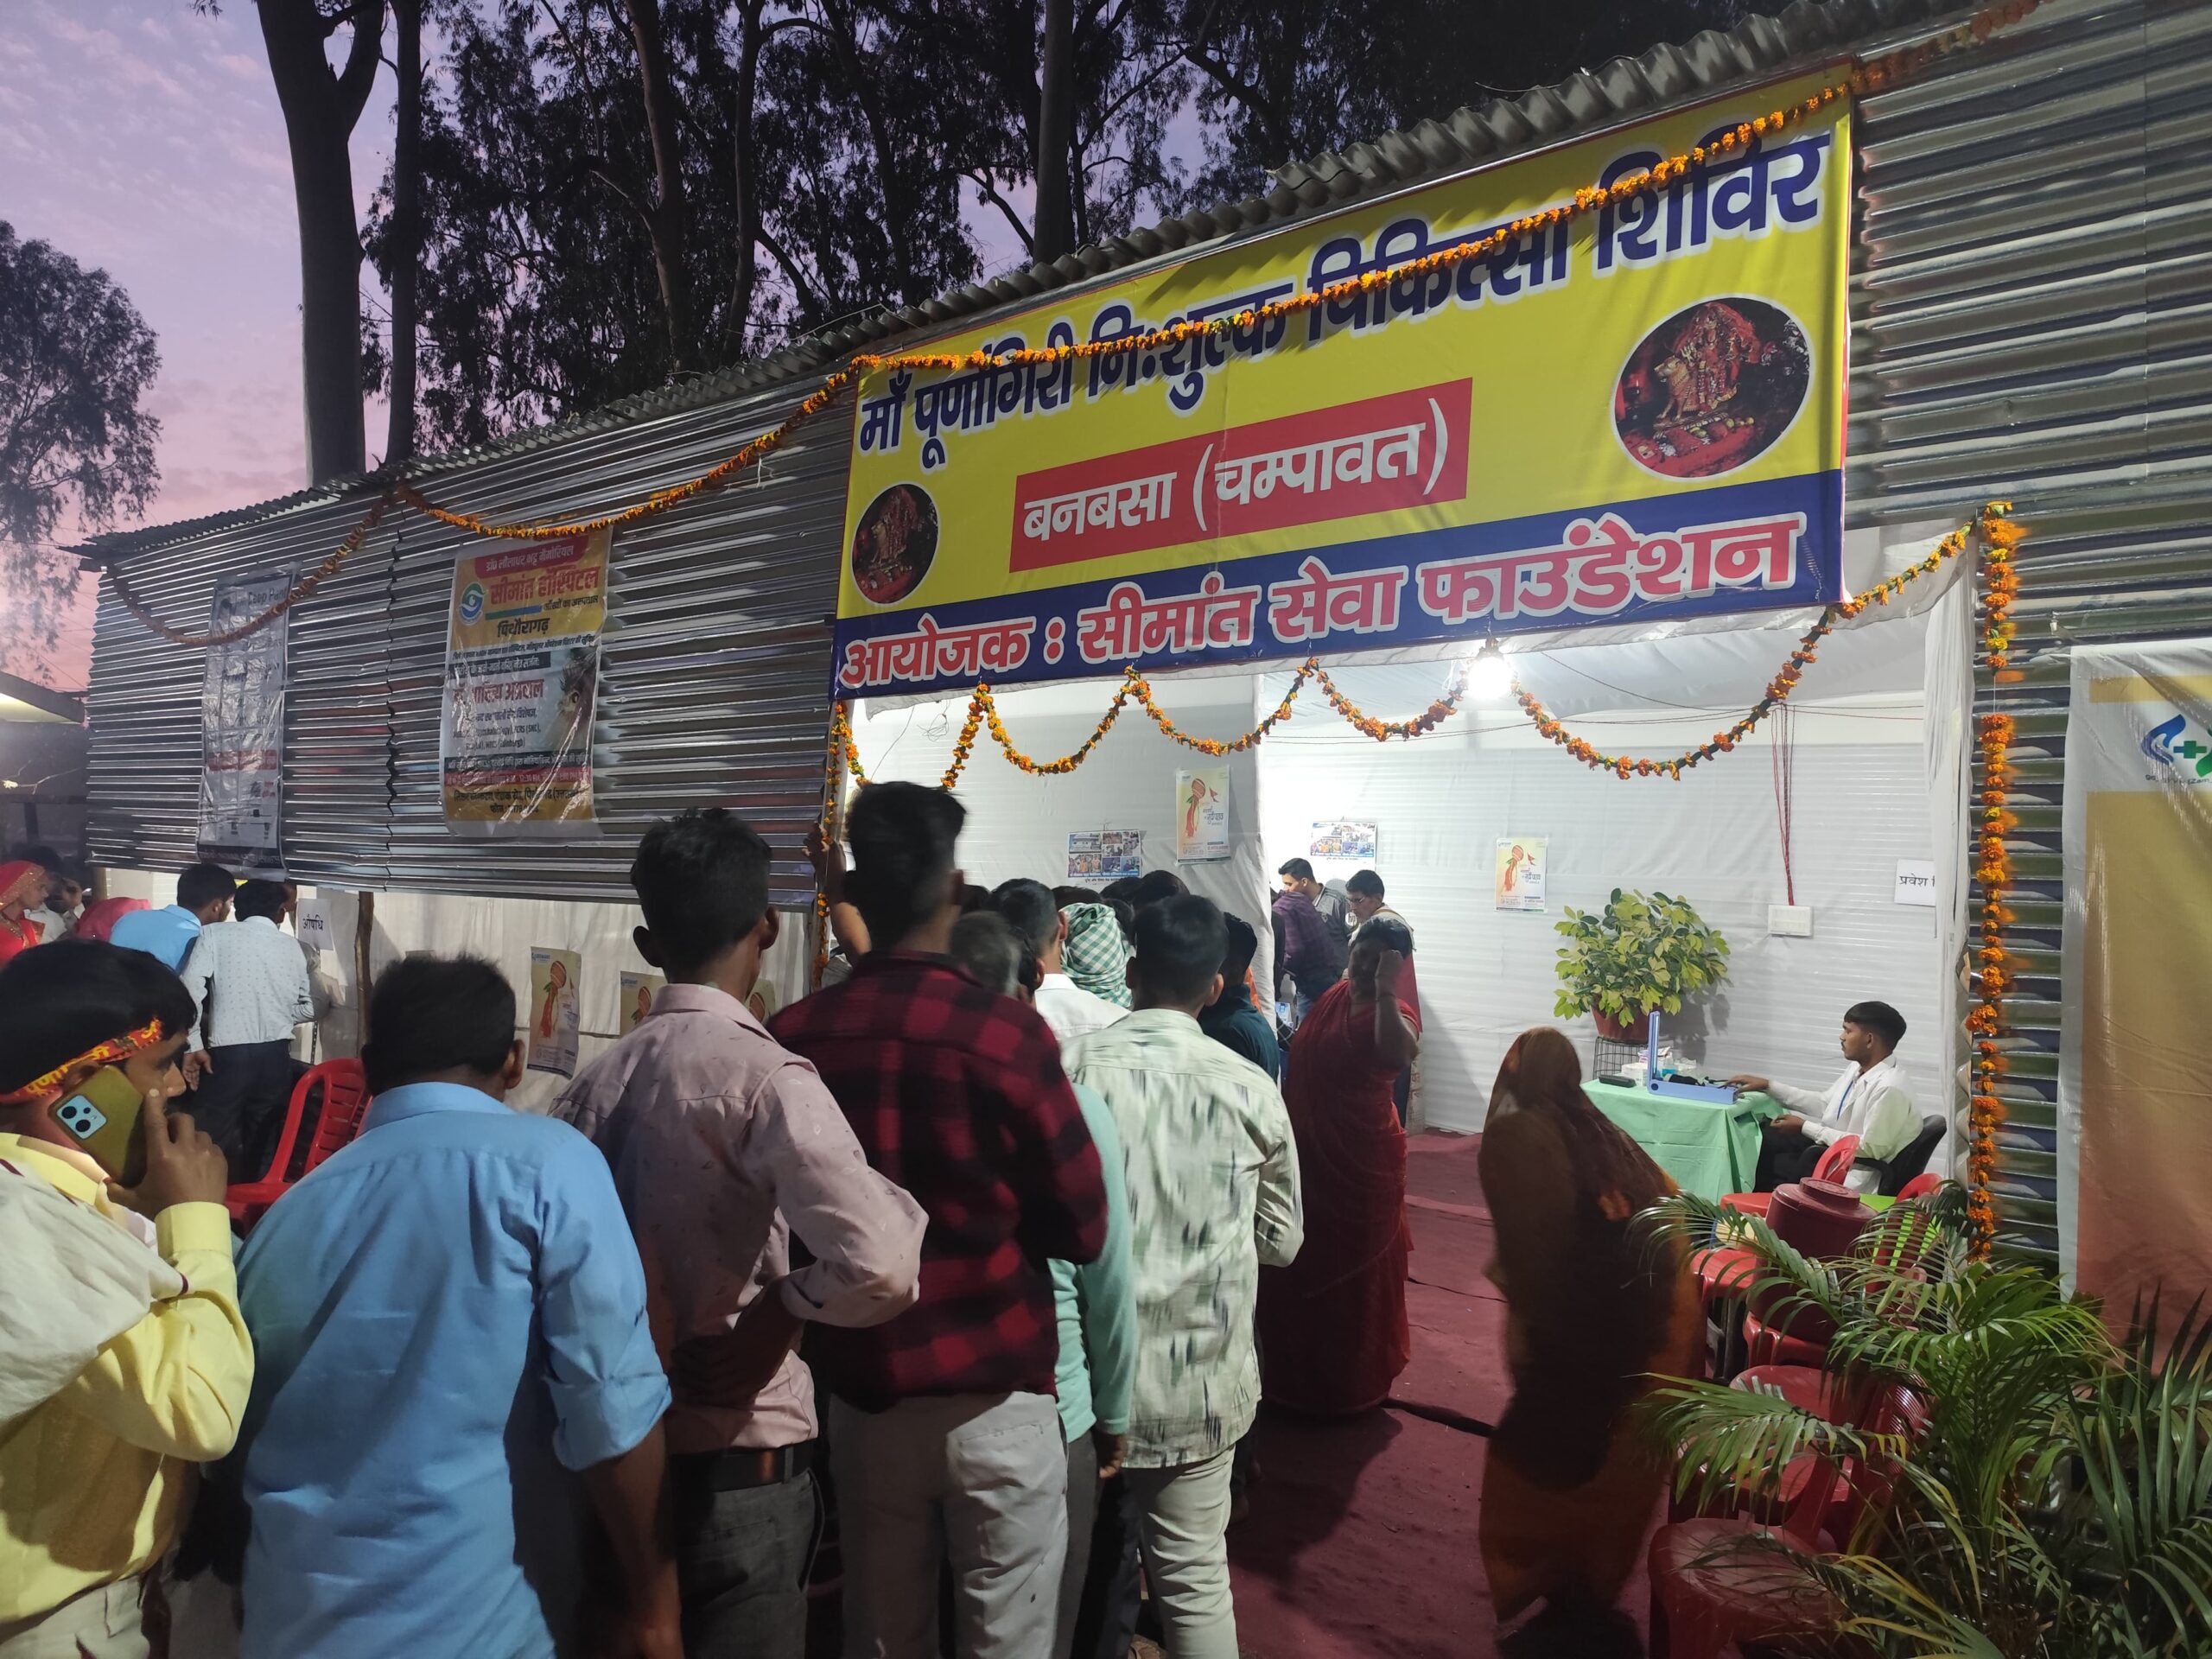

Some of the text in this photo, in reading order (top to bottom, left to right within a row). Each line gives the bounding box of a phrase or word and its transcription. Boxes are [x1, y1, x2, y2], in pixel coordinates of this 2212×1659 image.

[859, 370, 912, 452] माँ
[1592, 121, 1830, 270] शिविर
[1023, 397, 1448, 541] बनबसा (चम्पावत)
[497, 617, 550, 638] पिथौरागढ़
[842, 615, 1034, 685] आयोजक
[1081, 576, 1257, 659] सीमांत
[1274, 563, 1404, 638] सेवा
[1422, 519, 1800, 619] फाउंडेशन
[1898, 873, 1929, 887] प्रवेश
